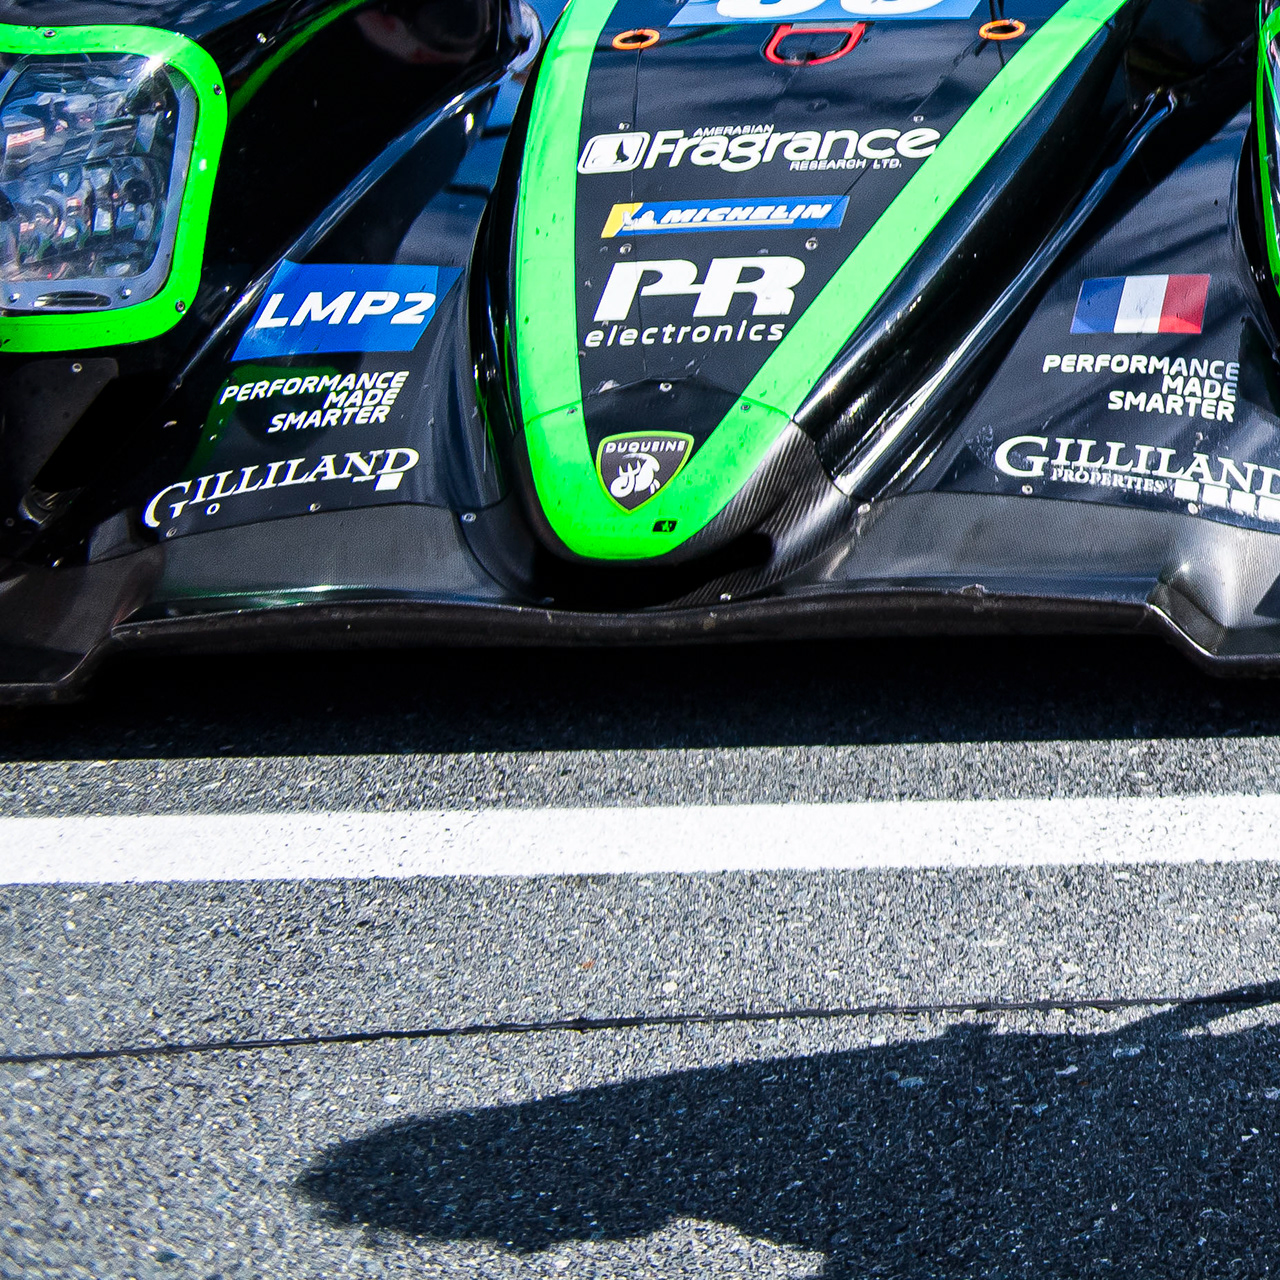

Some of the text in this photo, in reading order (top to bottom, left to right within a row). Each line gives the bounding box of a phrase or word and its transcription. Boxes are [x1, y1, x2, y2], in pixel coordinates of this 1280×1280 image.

[643, 127, 941, 172] Fragrance
[790, 157, 902, 170] RESEARCH LTD.
[659, 204, 834, 224] MICHELIN
[594, 256, 806, 321] PR
[253, 290, 437, 329] LMP2
[583, 319, 786, 348] electronics
[1042, 353, 1240, 382] PERFORMANCE
[220, 370, 409, 405] PERFORMANCE
[322, 387, 400, 409] MADE
[1160, 375, 1238, 402] MADE
[267, 405, 391, 433] SMARTER
[1107, 390, 1236, 423] SMARTER
[604, 440, 686, 454] DUQUEINE
[1050, 467, 1168, 494] PROPERTIES
